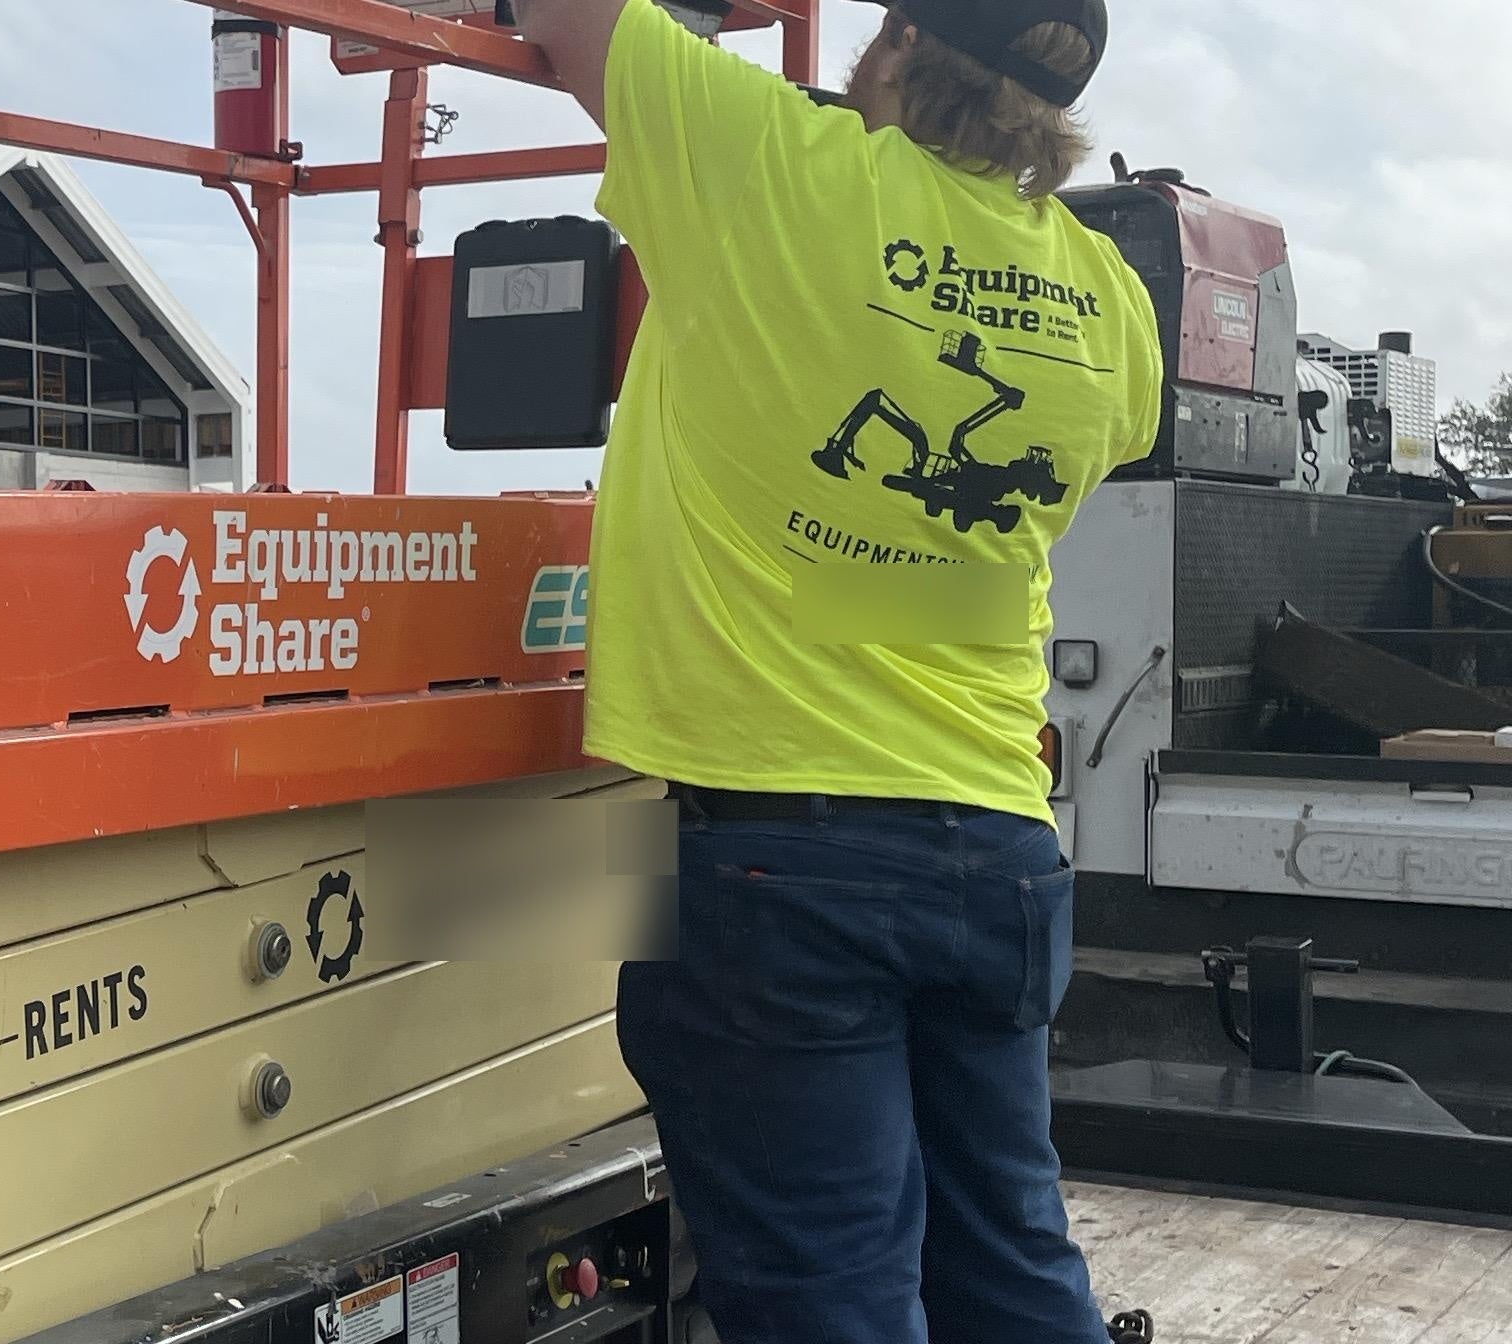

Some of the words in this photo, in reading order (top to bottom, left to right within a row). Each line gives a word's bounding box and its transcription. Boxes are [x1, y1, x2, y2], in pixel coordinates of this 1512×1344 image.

[931, 282, 1041, 333] Share
[1214, 295, 1248, 320] LINCOLN
[211, 510, 478, 601] Equipment
[208, 602, 359, 677] Share
